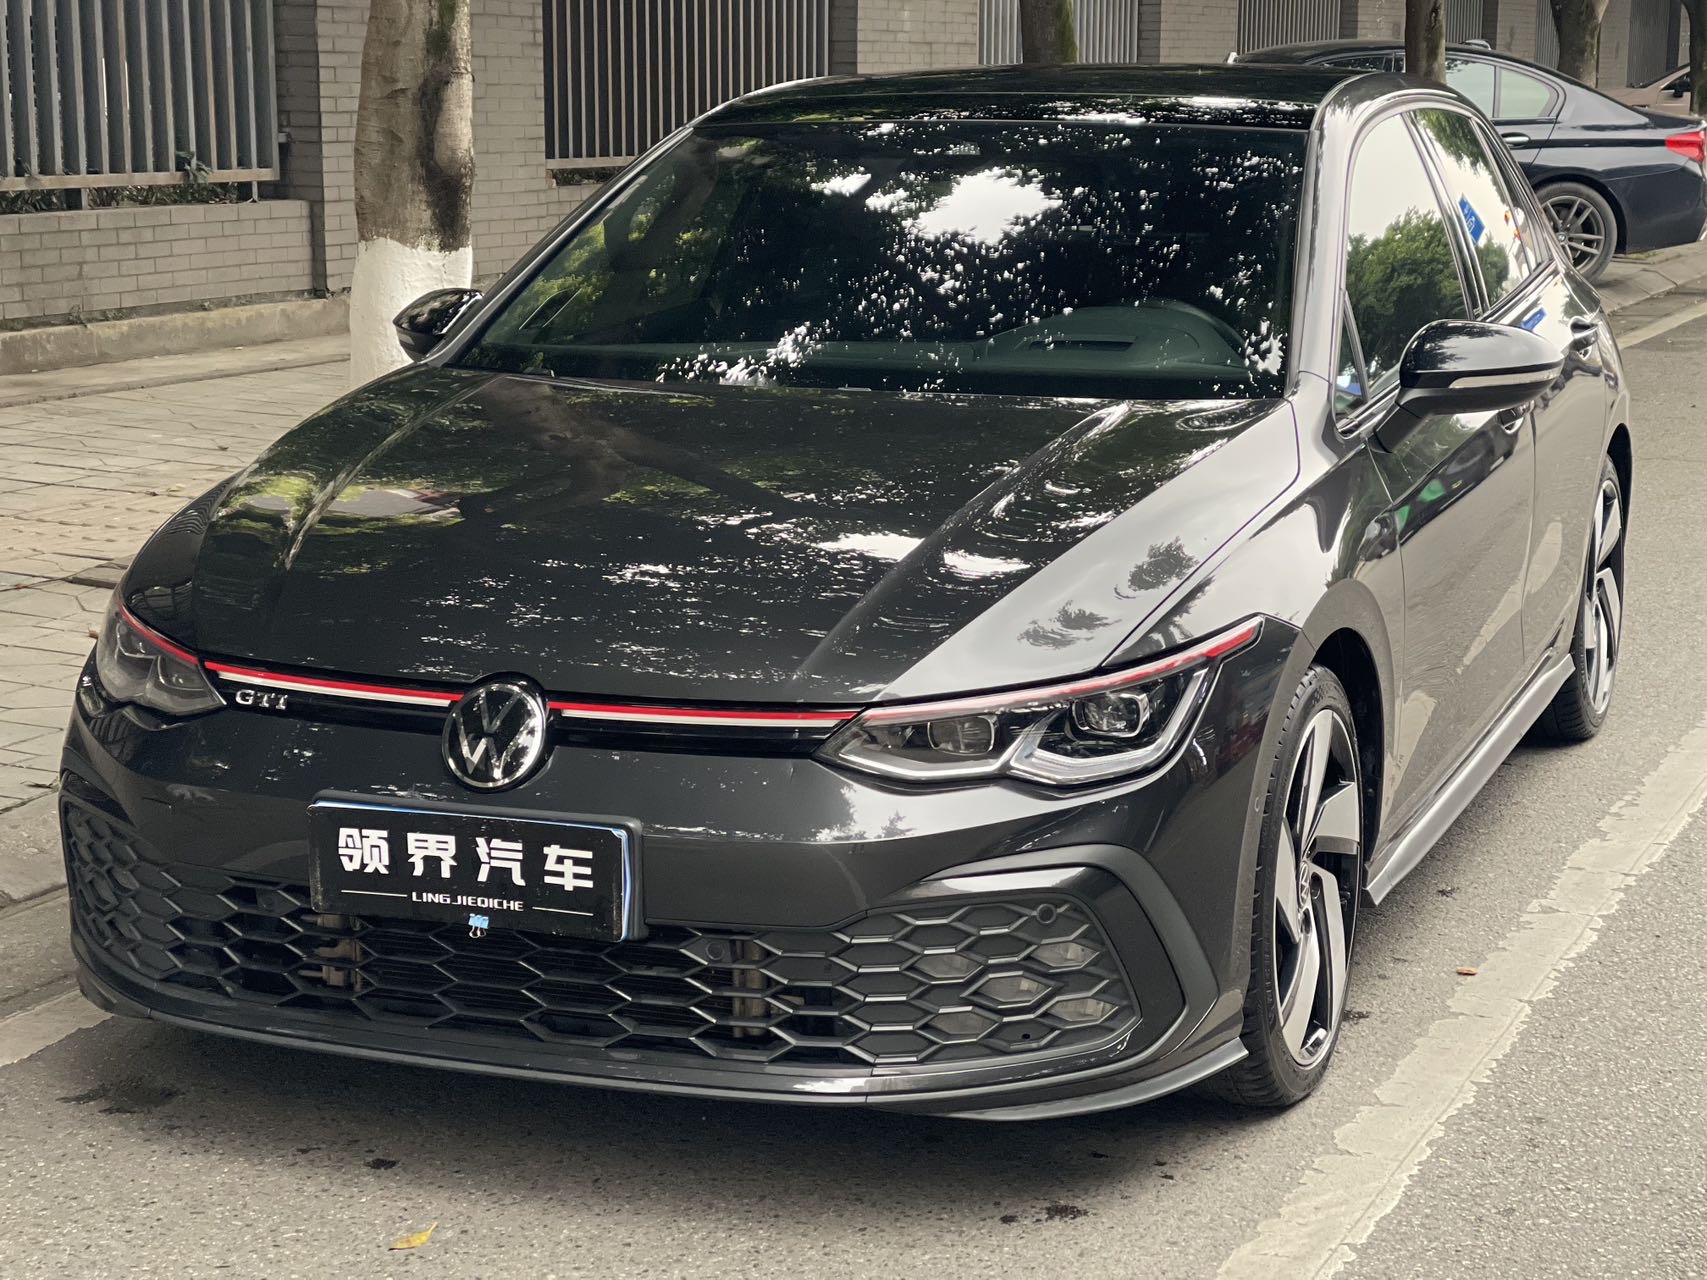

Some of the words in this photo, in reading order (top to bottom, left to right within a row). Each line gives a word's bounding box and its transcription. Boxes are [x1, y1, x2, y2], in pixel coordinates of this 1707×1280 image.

[235, 689, 288, 710] GTI
[338, 827, 594, 891] 领界汽车
[411, 891, 524, 911] LINGJIEQICHE
